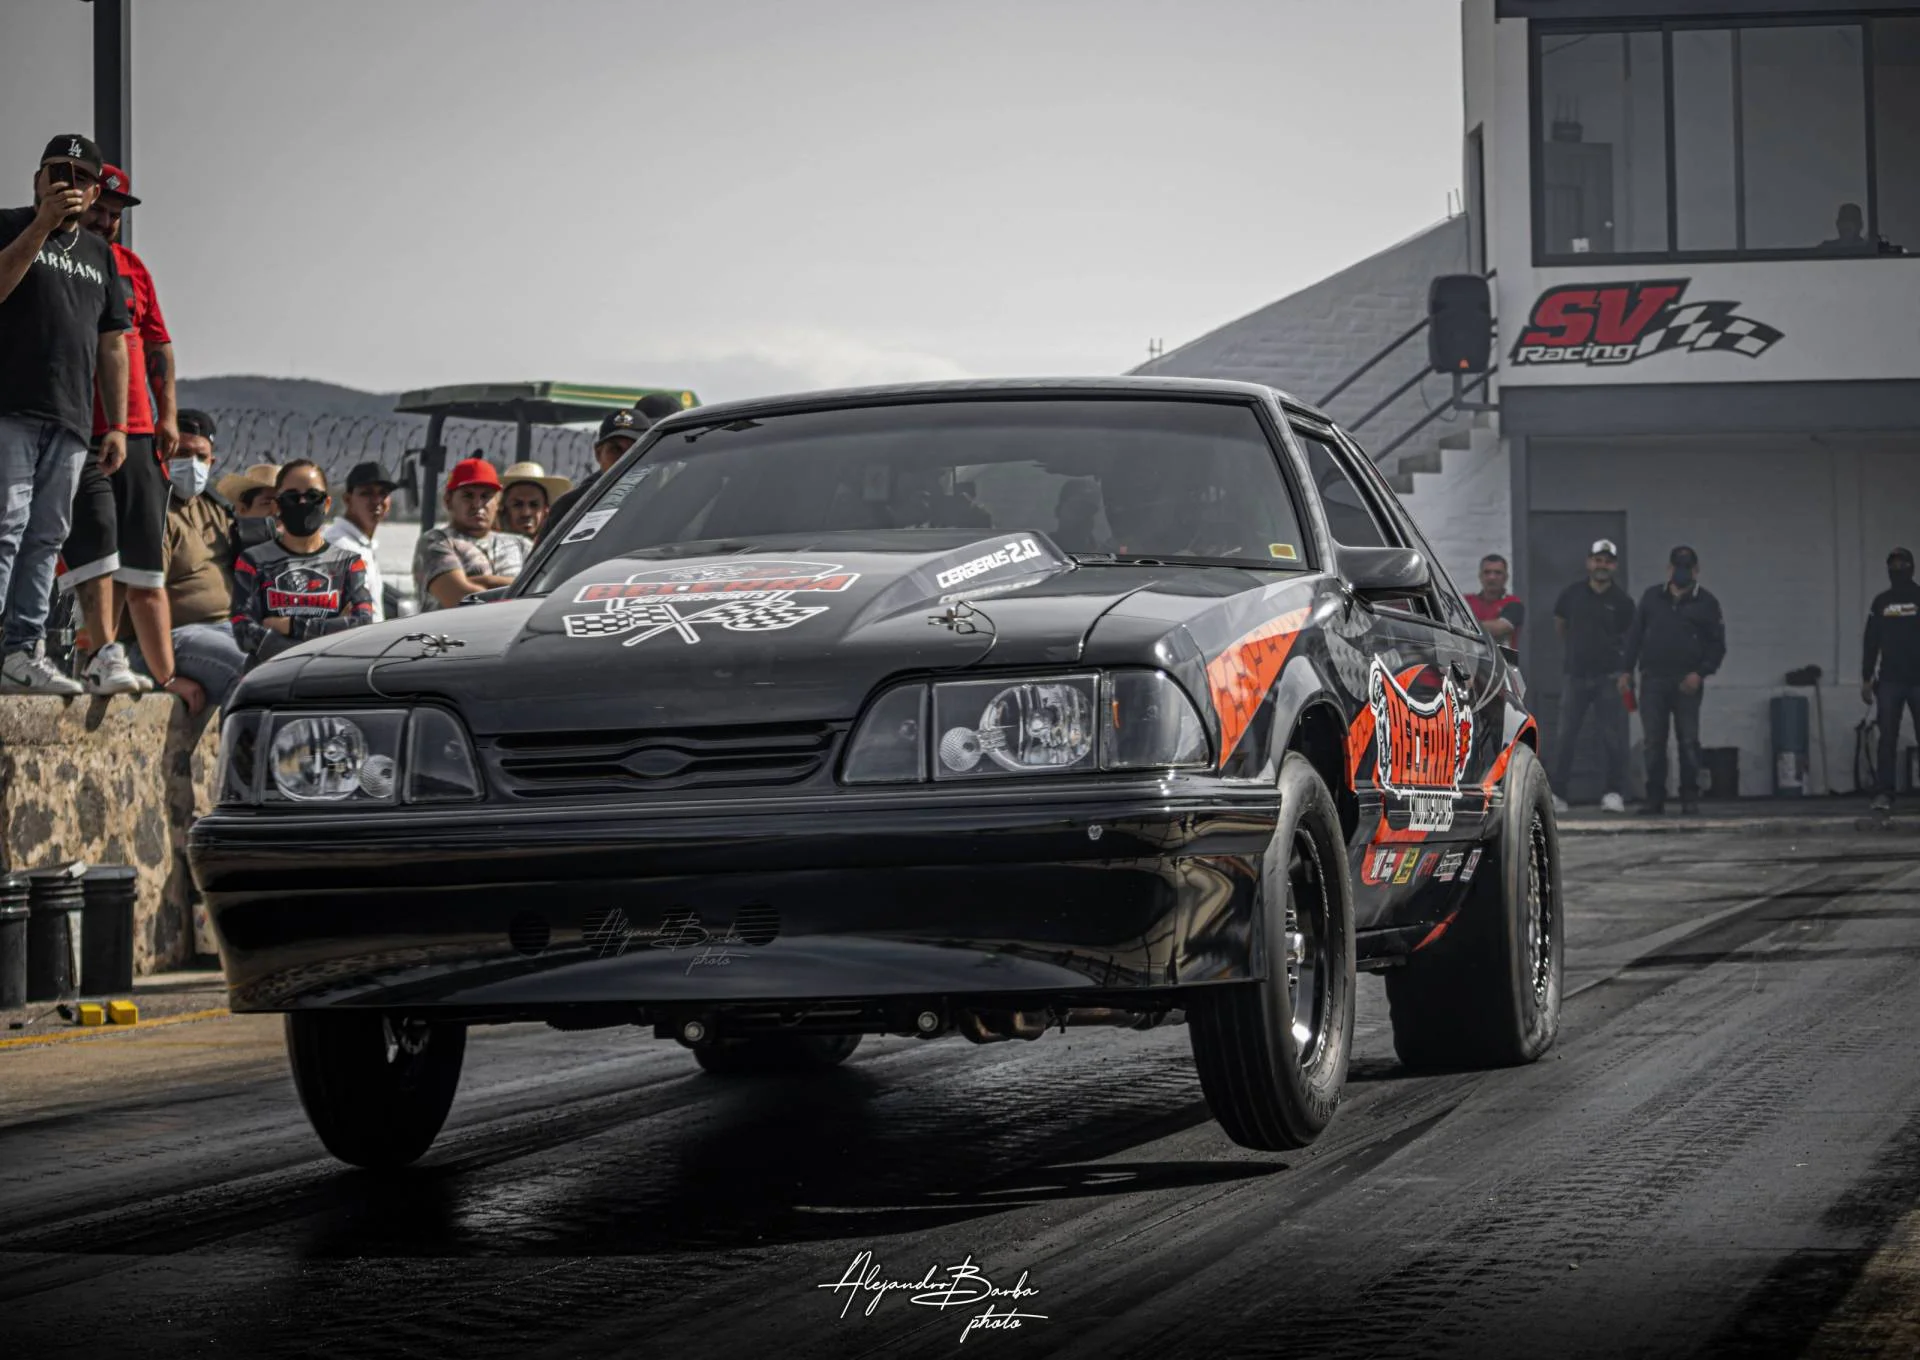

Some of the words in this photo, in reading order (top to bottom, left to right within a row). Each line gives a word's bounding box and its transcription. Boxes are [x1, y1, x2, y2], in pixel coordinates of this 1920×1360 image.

[68, 138, 82, 158] LA
[34, 250, 103, 285] ARMANI
[1522, 285, 1680, 346] SV
[1516, 342, 1638, 364] Racing
[936, 548, 1011, 589] CERBERUS
[1004, 538, 1042, 573] 2.0
[583, 574, 850, 601] BECERRA
[1382, 674, 1457, 787] BECERRA
